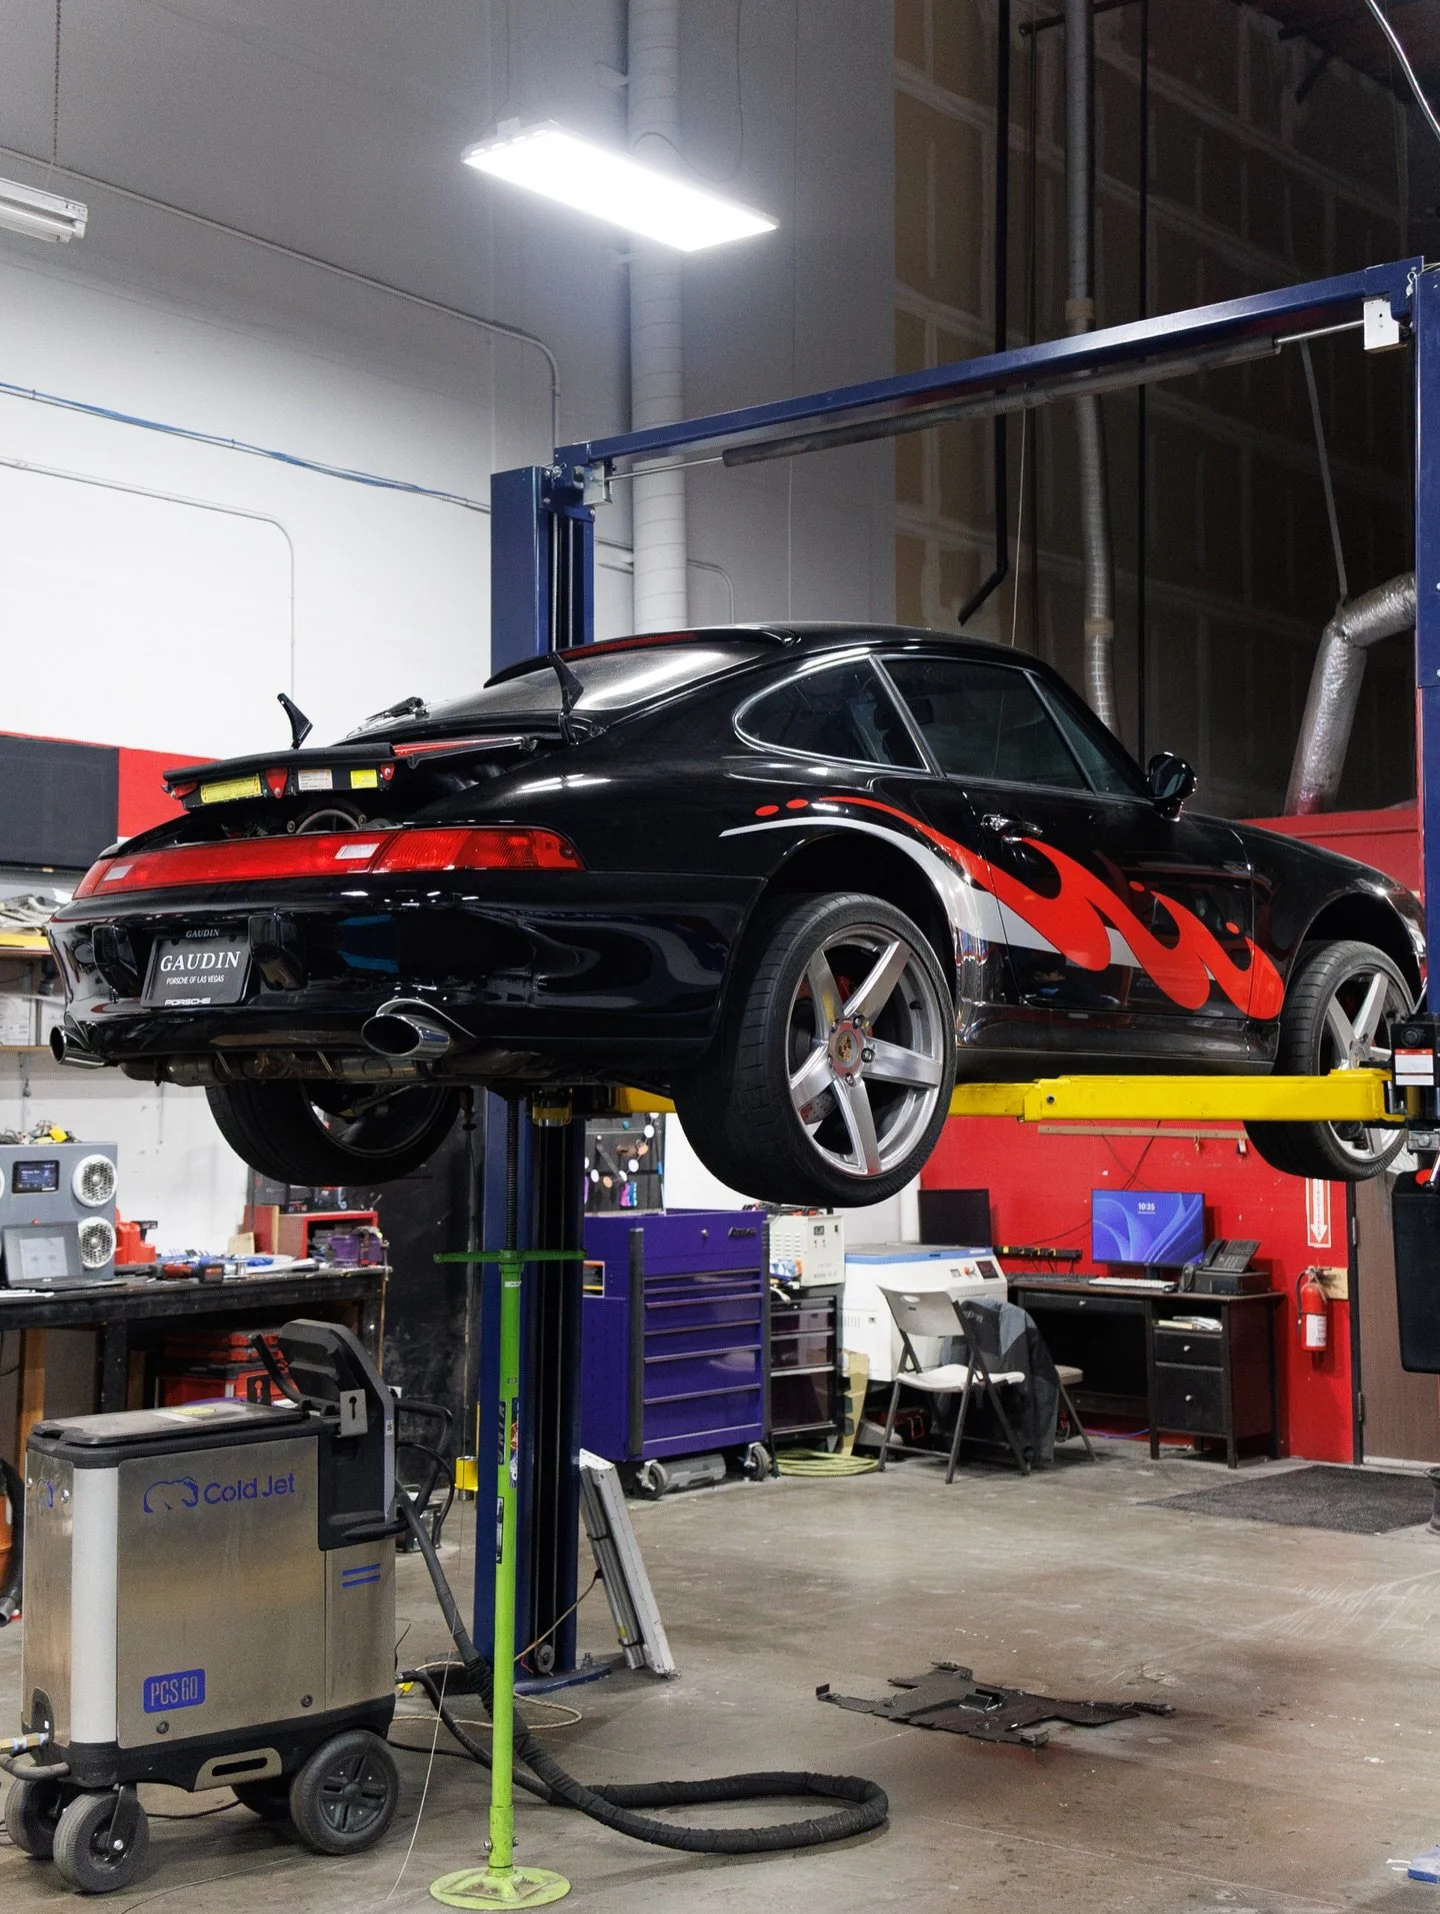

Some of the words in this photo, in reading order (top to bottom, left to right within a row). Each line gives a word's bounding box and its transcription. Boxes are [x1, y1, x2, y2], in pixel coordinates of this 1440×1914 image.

[186, 929, 220, 938] GAUDIN
[160, 951, 241, 972] GAUDIN
[166, 976, 189, 985] PORSCHE
[189, 975, 197, 984] OF
[196, 975, 208, 984] LAS
[207, 974, 225, 983] VEGAS
[164, 997, 211, 1006] PORSCHE
[203, 1477, 258, 1505] Cold
[262, 1472, 295, 1497] Jet
[151, 1680, 179, 1707] PCS
